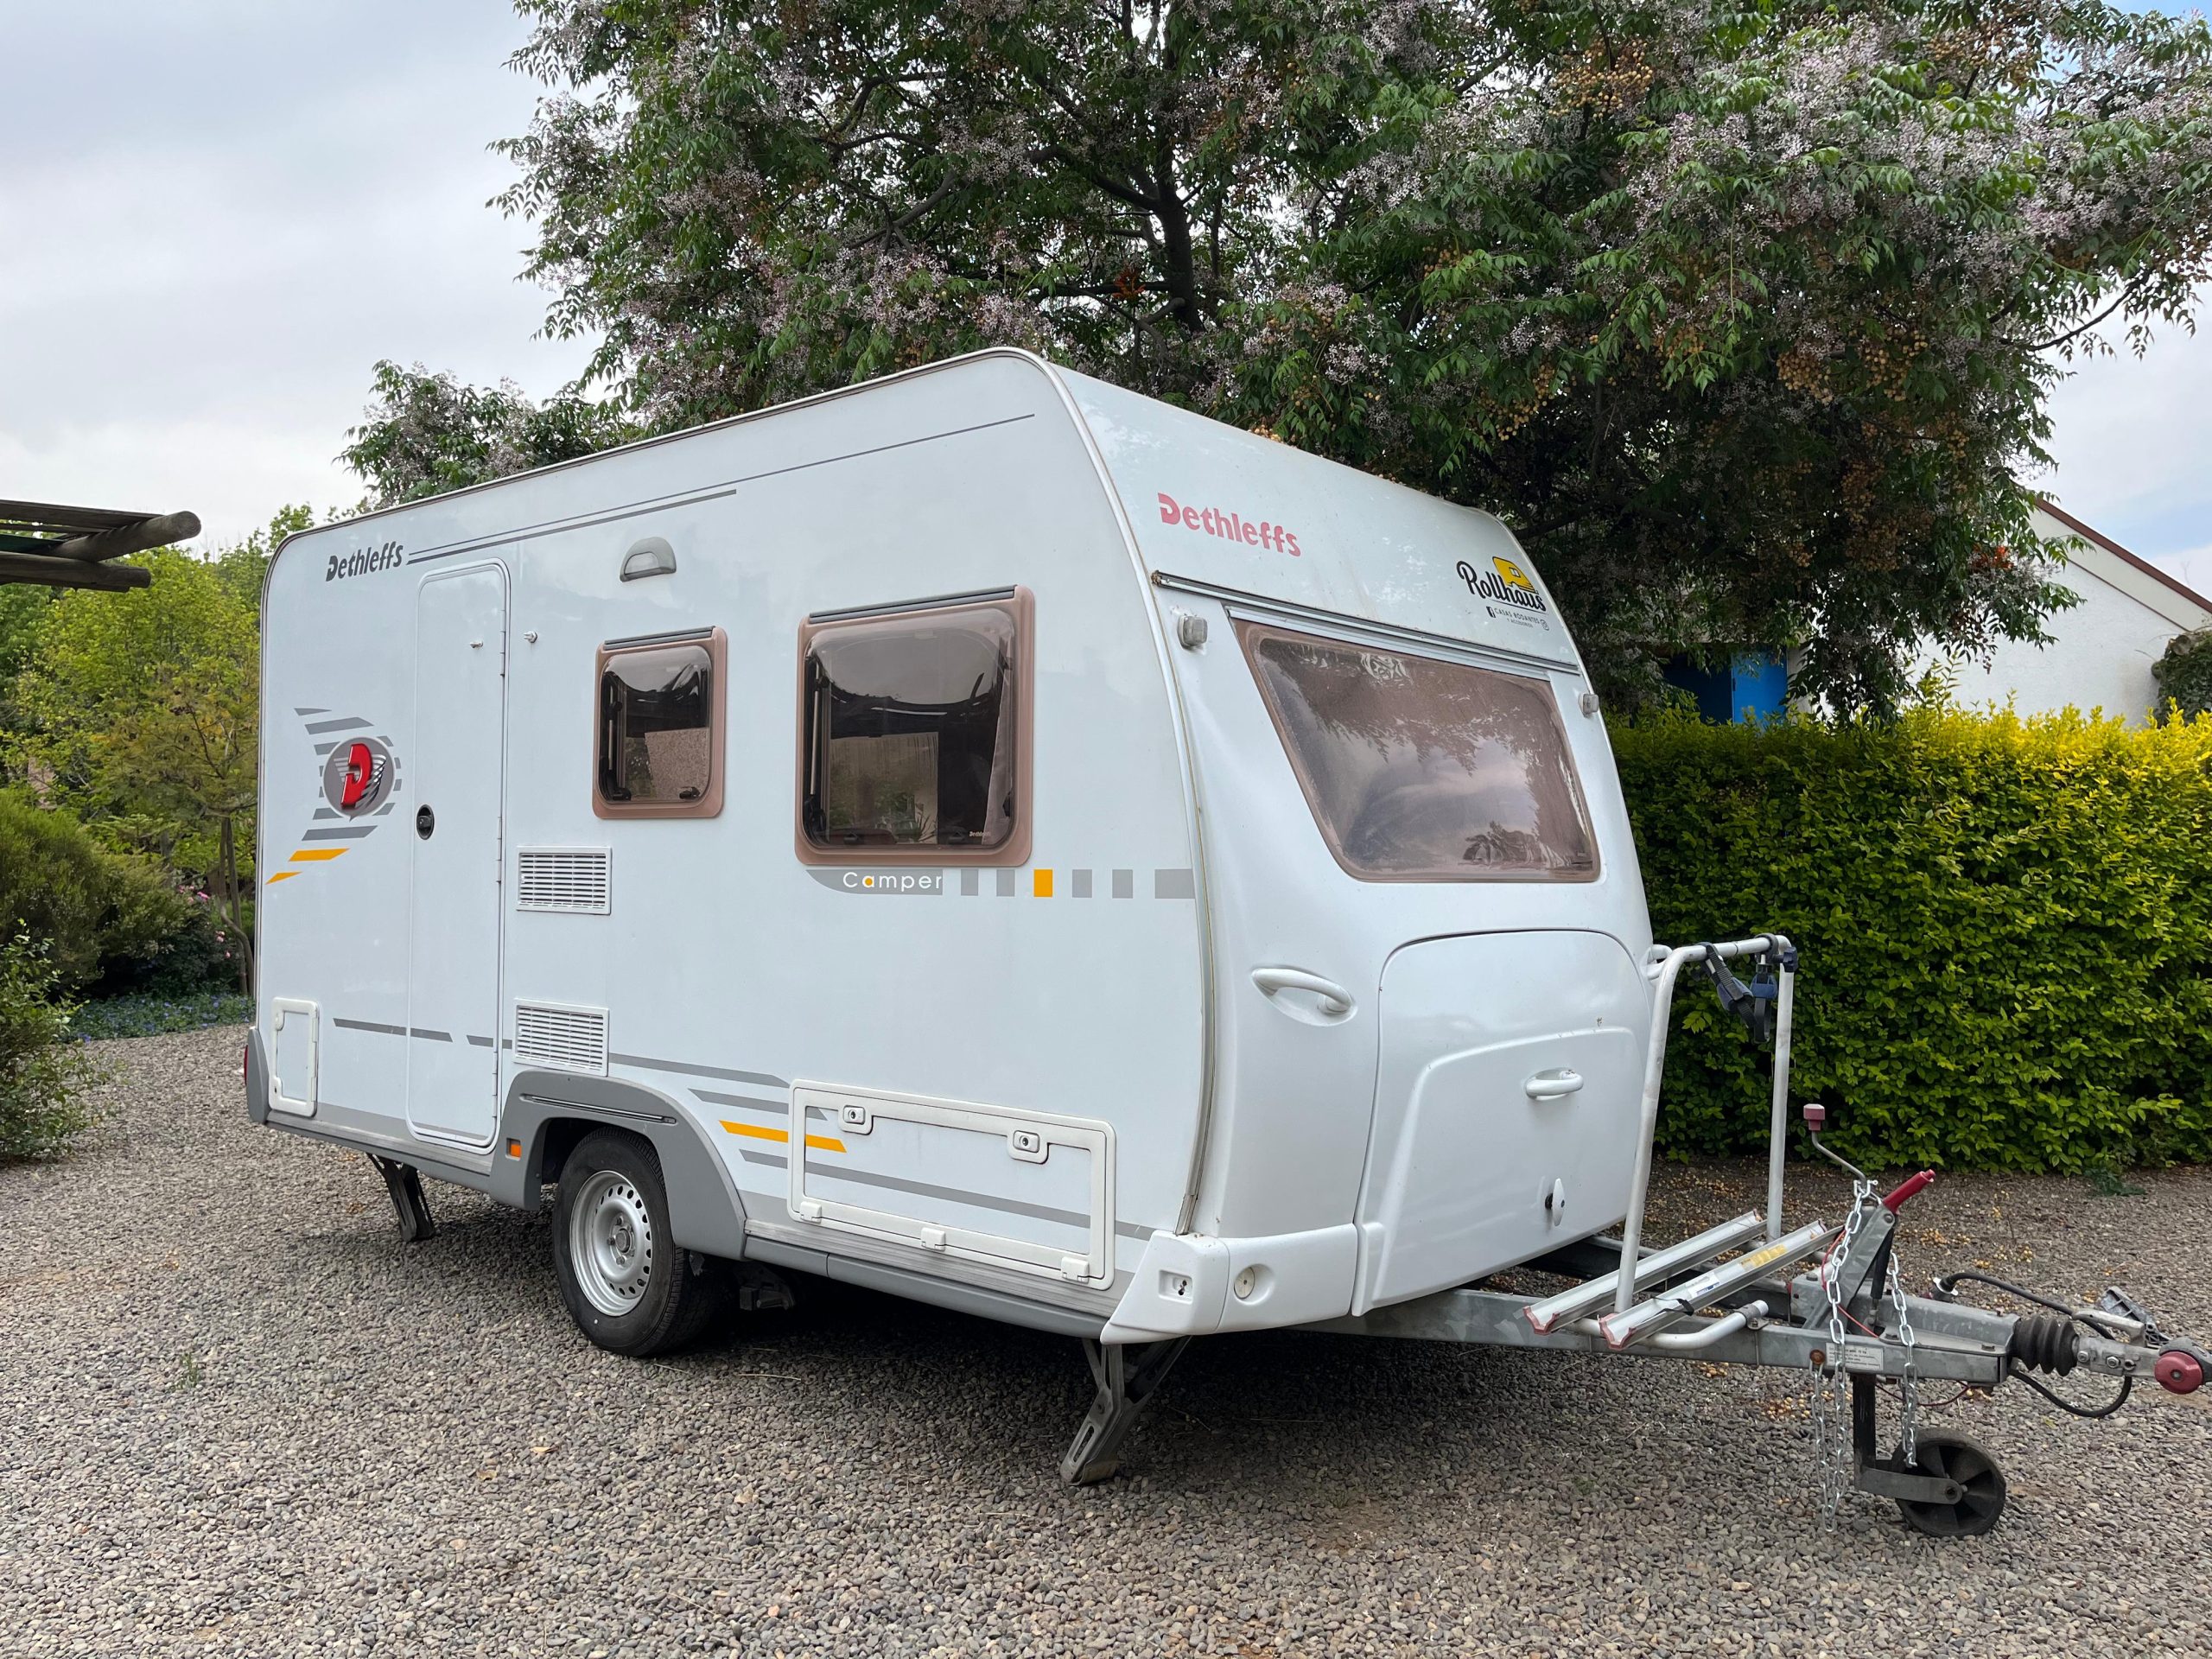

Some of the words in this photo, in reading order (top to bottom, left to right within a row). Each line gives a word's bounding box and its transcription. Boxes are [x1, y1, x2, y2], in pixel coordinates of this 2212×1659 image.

[1157, 493, 1301, 557] Dethleffs
[326, 541, 404, 582] Dethleffs
[1456, 561, 1547, 612] Rollhaus
[842, 872, 942, 893] Camper
